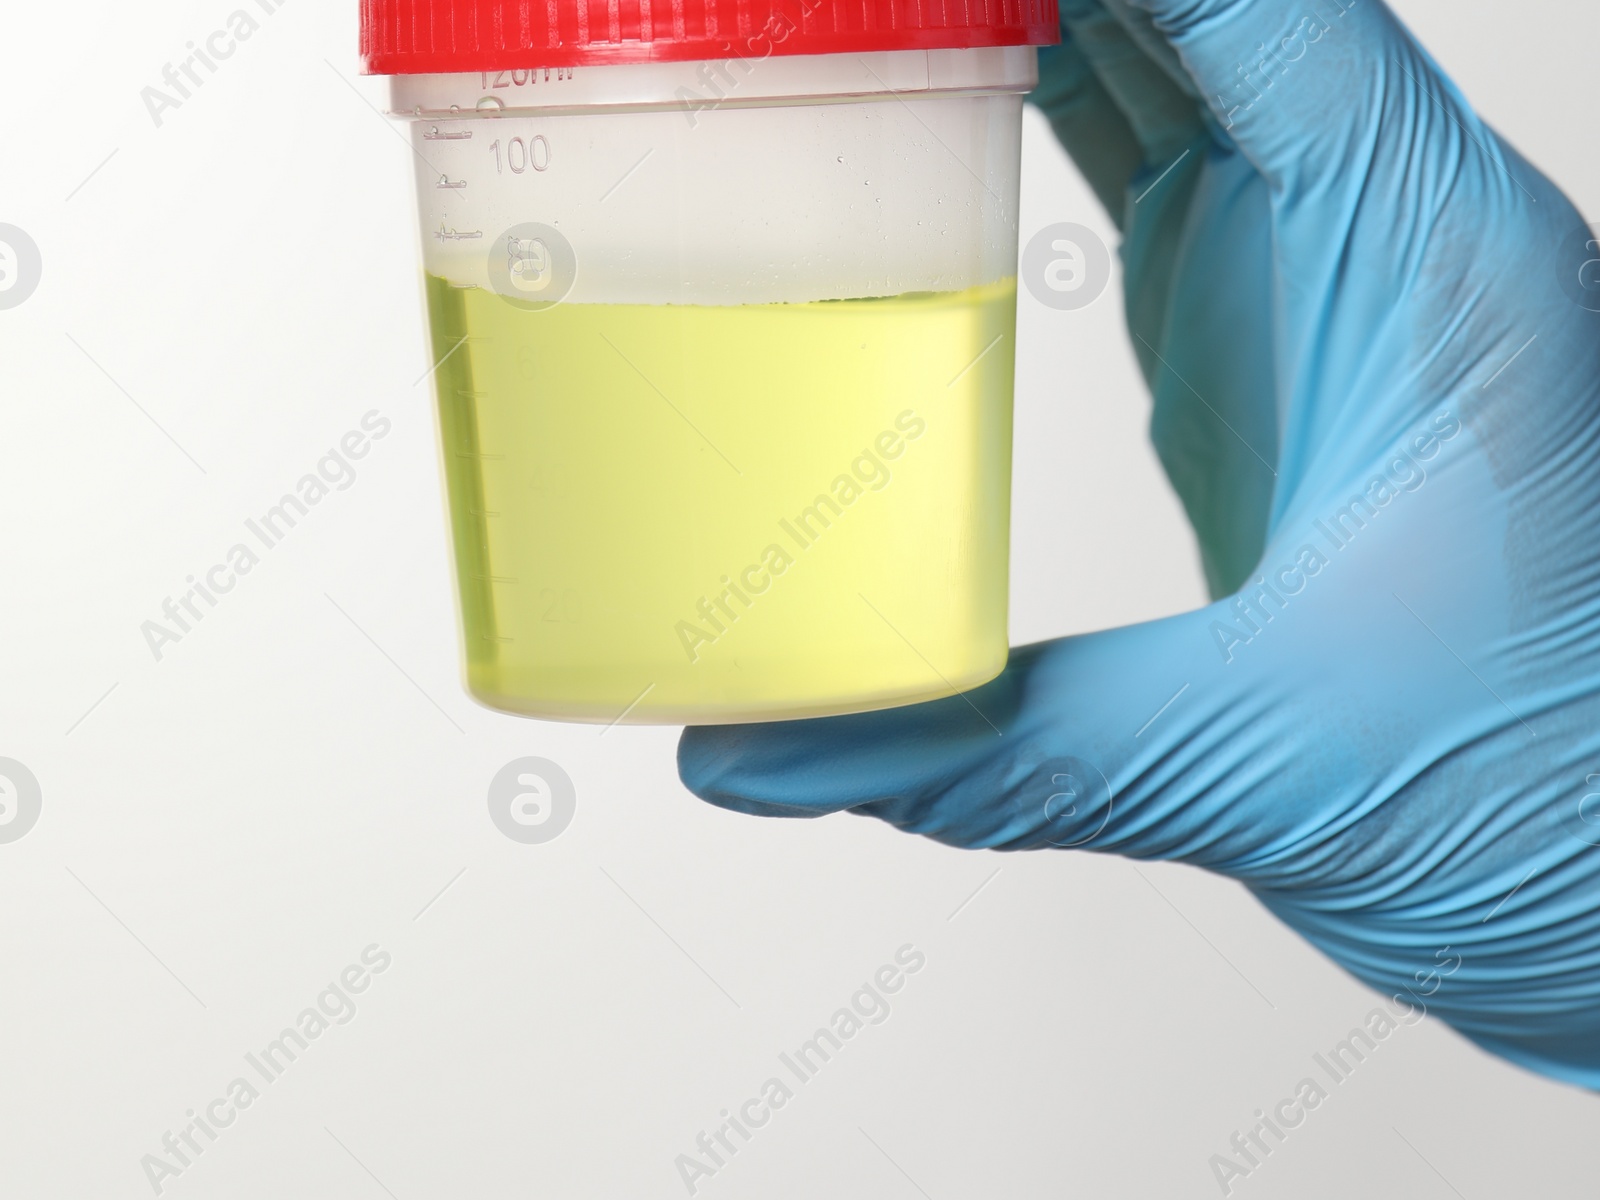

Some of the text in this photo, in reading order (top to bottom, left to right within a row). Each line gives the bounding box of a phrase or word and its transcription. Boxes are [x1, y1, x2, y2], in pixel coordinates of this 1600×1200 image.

[489, 134, 551, 175] 100
[507, 236, 546, 274] 80
[540, 587, 583, 623] 20
